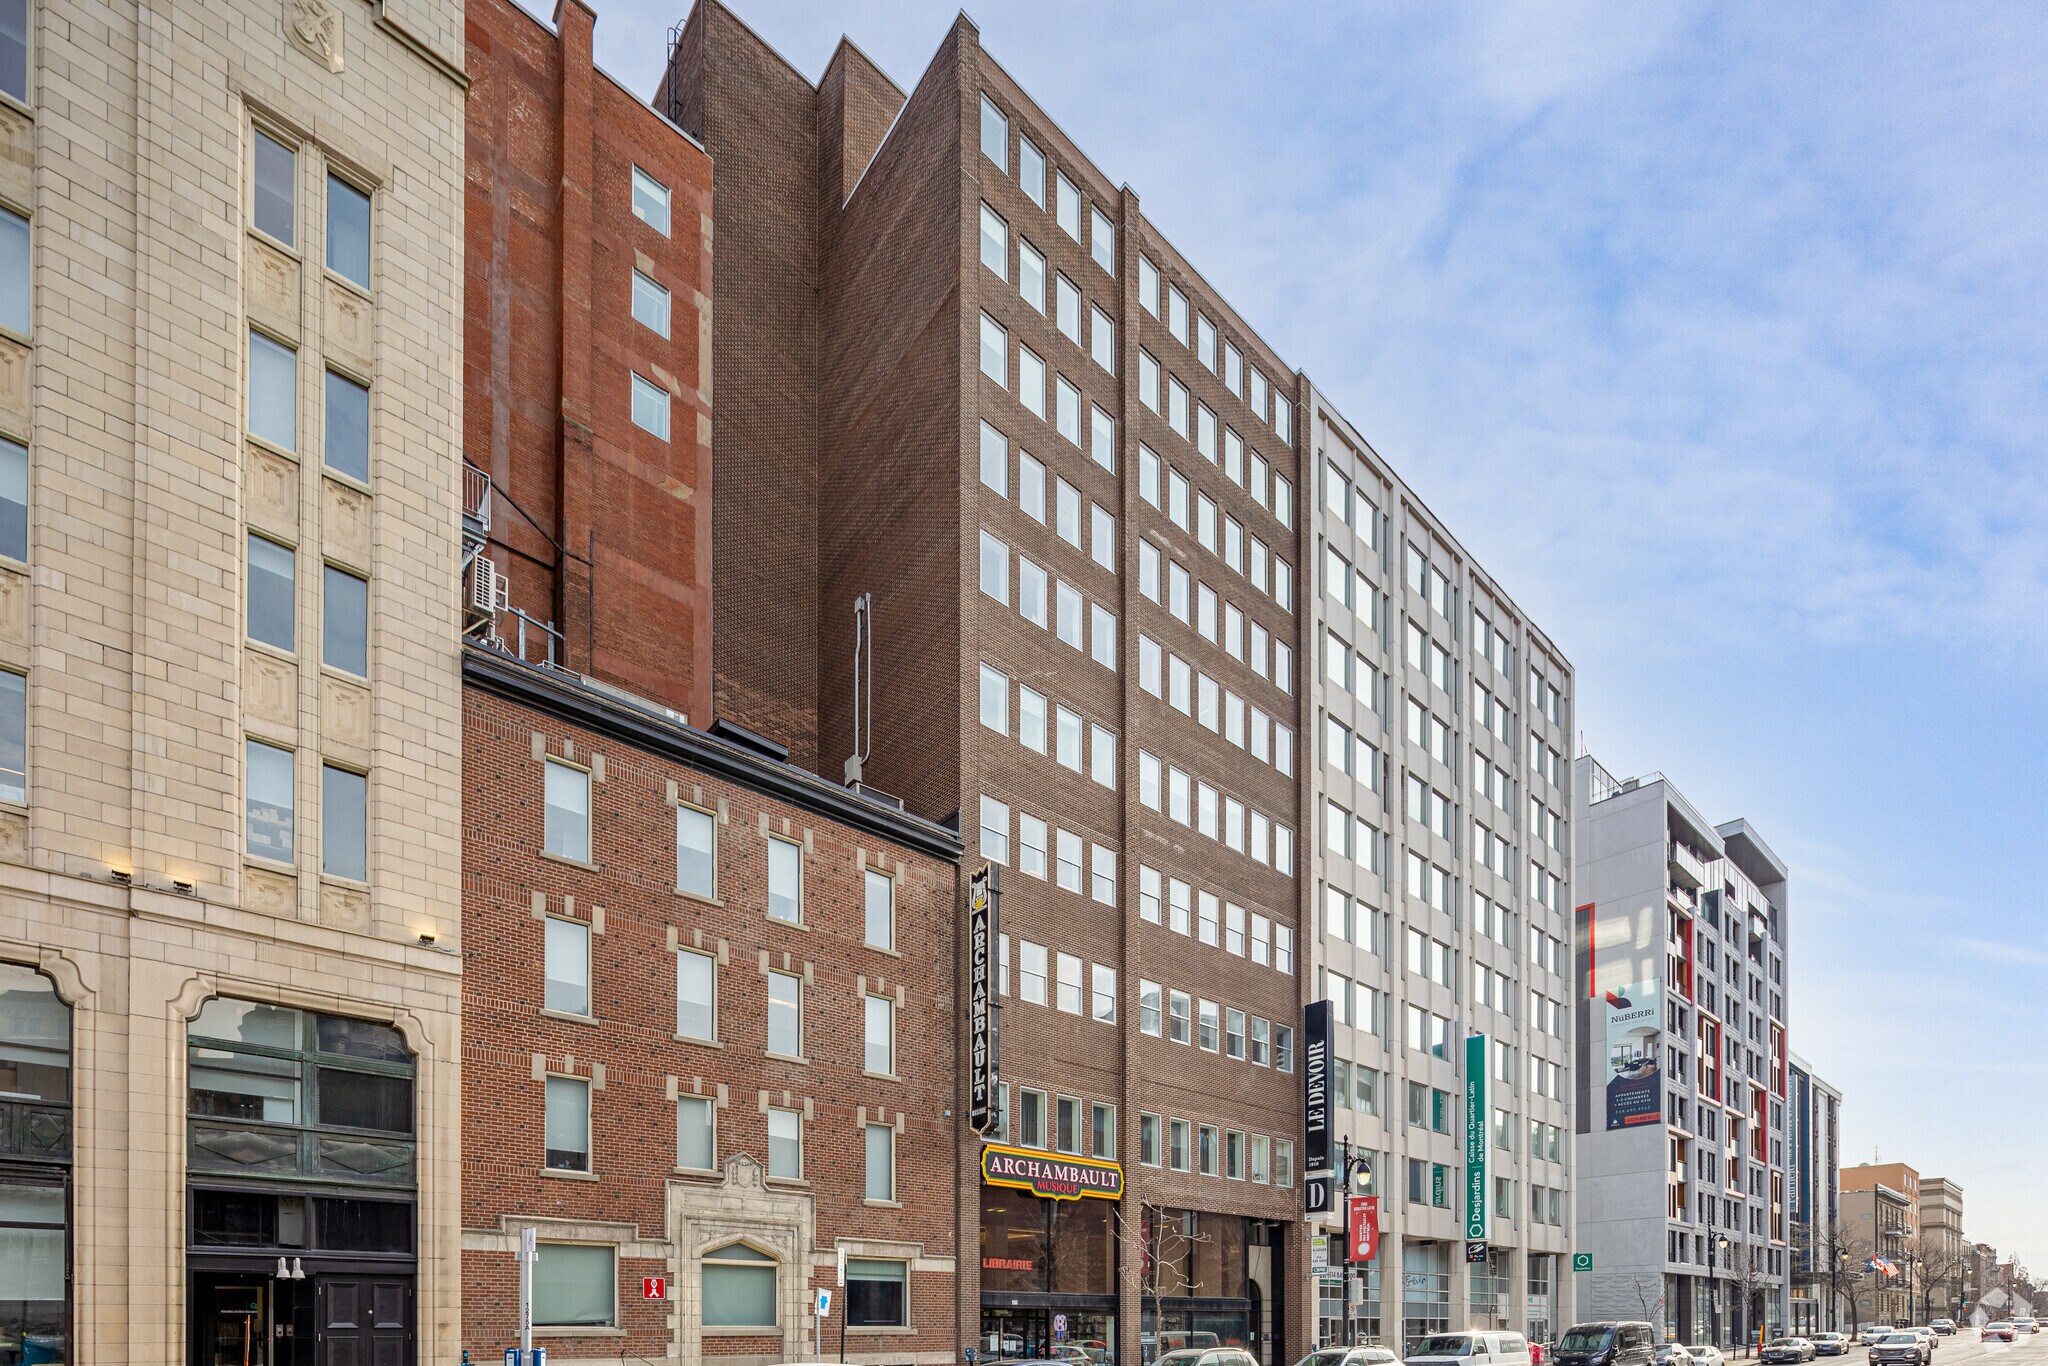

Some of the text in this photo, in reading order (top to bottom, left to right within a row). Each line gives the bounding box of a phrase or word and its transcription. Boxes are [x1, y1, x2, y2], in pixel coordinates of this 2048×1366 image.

[973, 915, 987, 1101] ARCHAMBAULT
[1308, 1040, 1325, 1133] LE DEVOIR
[1468, 1081, 1476, 1164] Caisse du Quartier-Latin
[990, 1156, 1118, 1188] ARCHAMBAULT
[1478, 1152, 1484, 1162] de
[1037, 1180, 1078, 1194] MUSIQUE
[1309, 1182, 1325, 1209] D
[1471, 1171, 1482, 1222] Desjardins
[983, 1257, 1033, 1271] LIBRAIRIE
